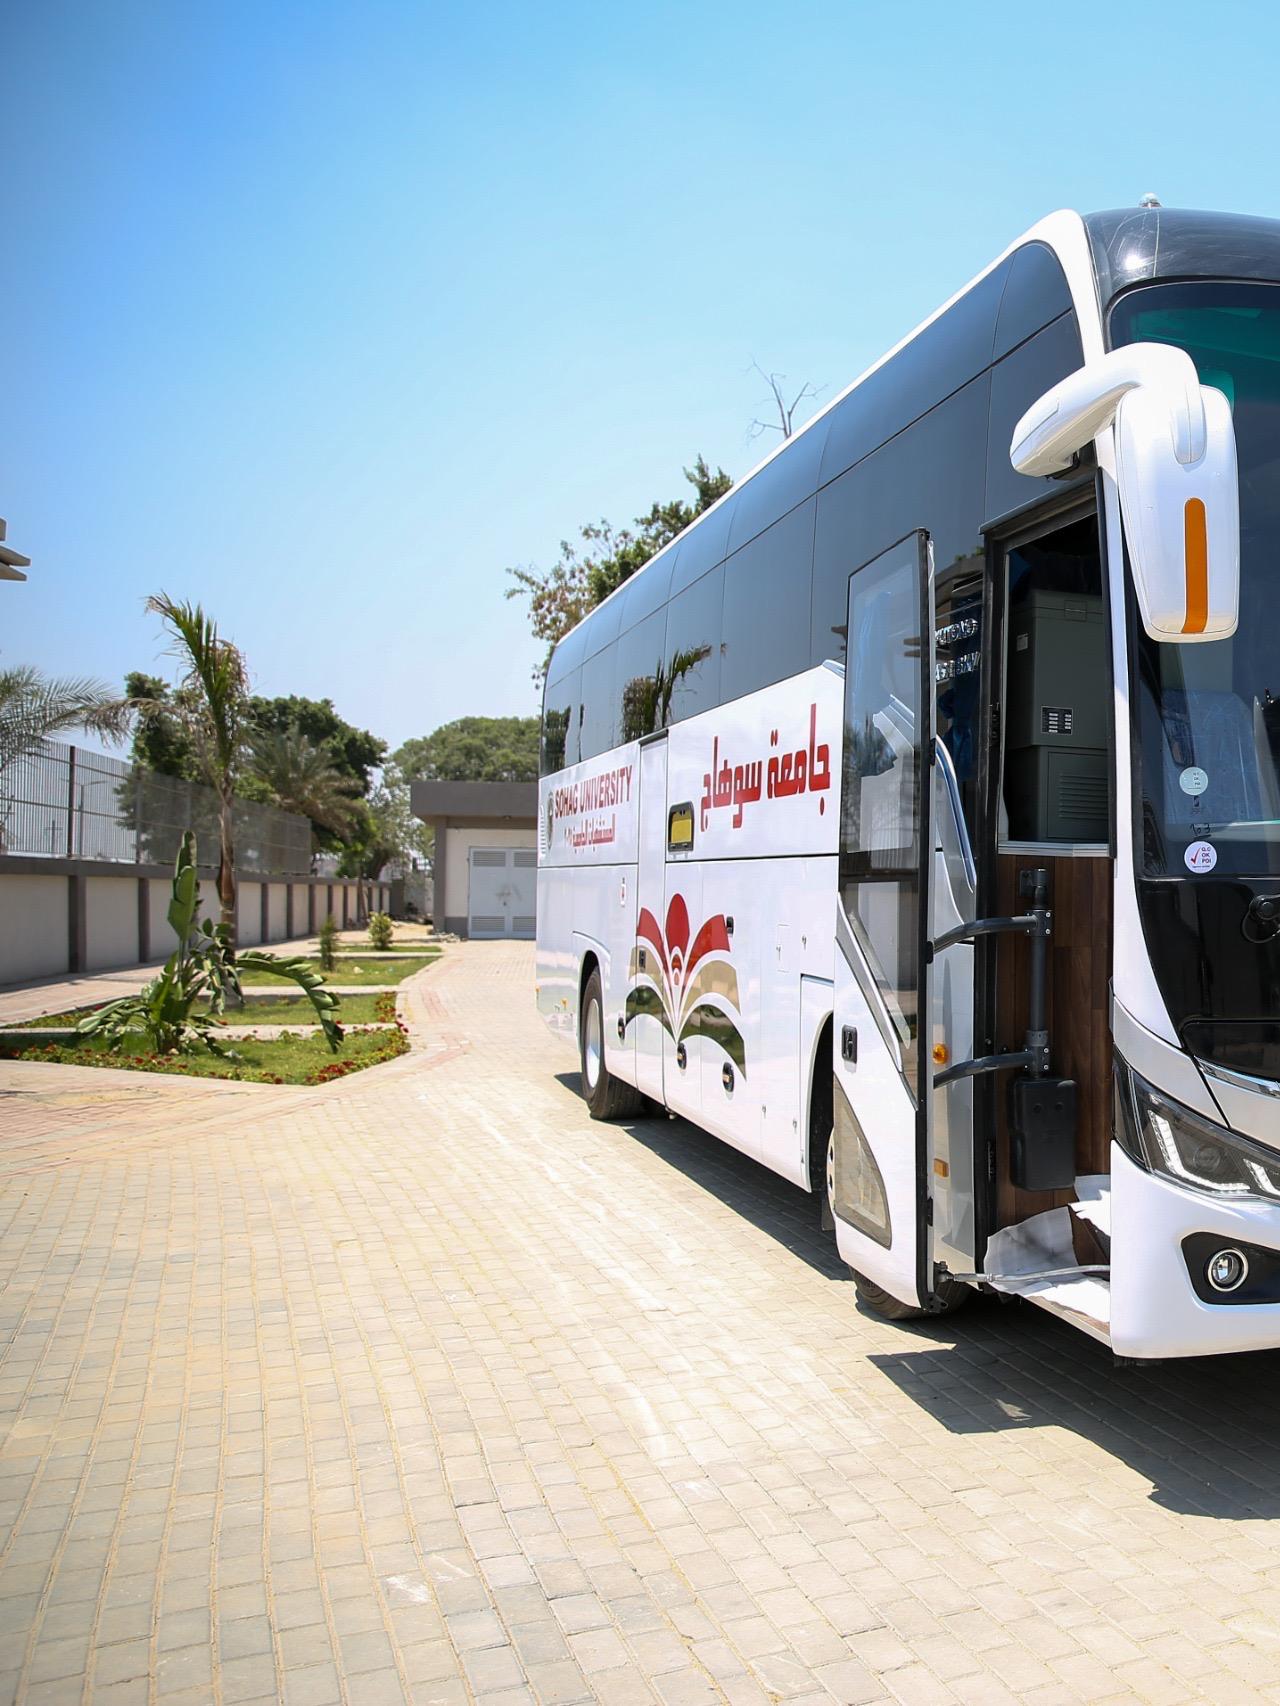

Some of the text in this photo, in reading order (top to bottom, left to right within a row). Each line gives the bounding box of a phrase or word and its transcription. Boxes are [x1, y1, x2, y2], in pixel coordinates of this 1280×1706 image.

[554, 765, 633, 819] SOHAG UNIVERSITY
[700, 703, 831, 832] جامعة سوهاج
